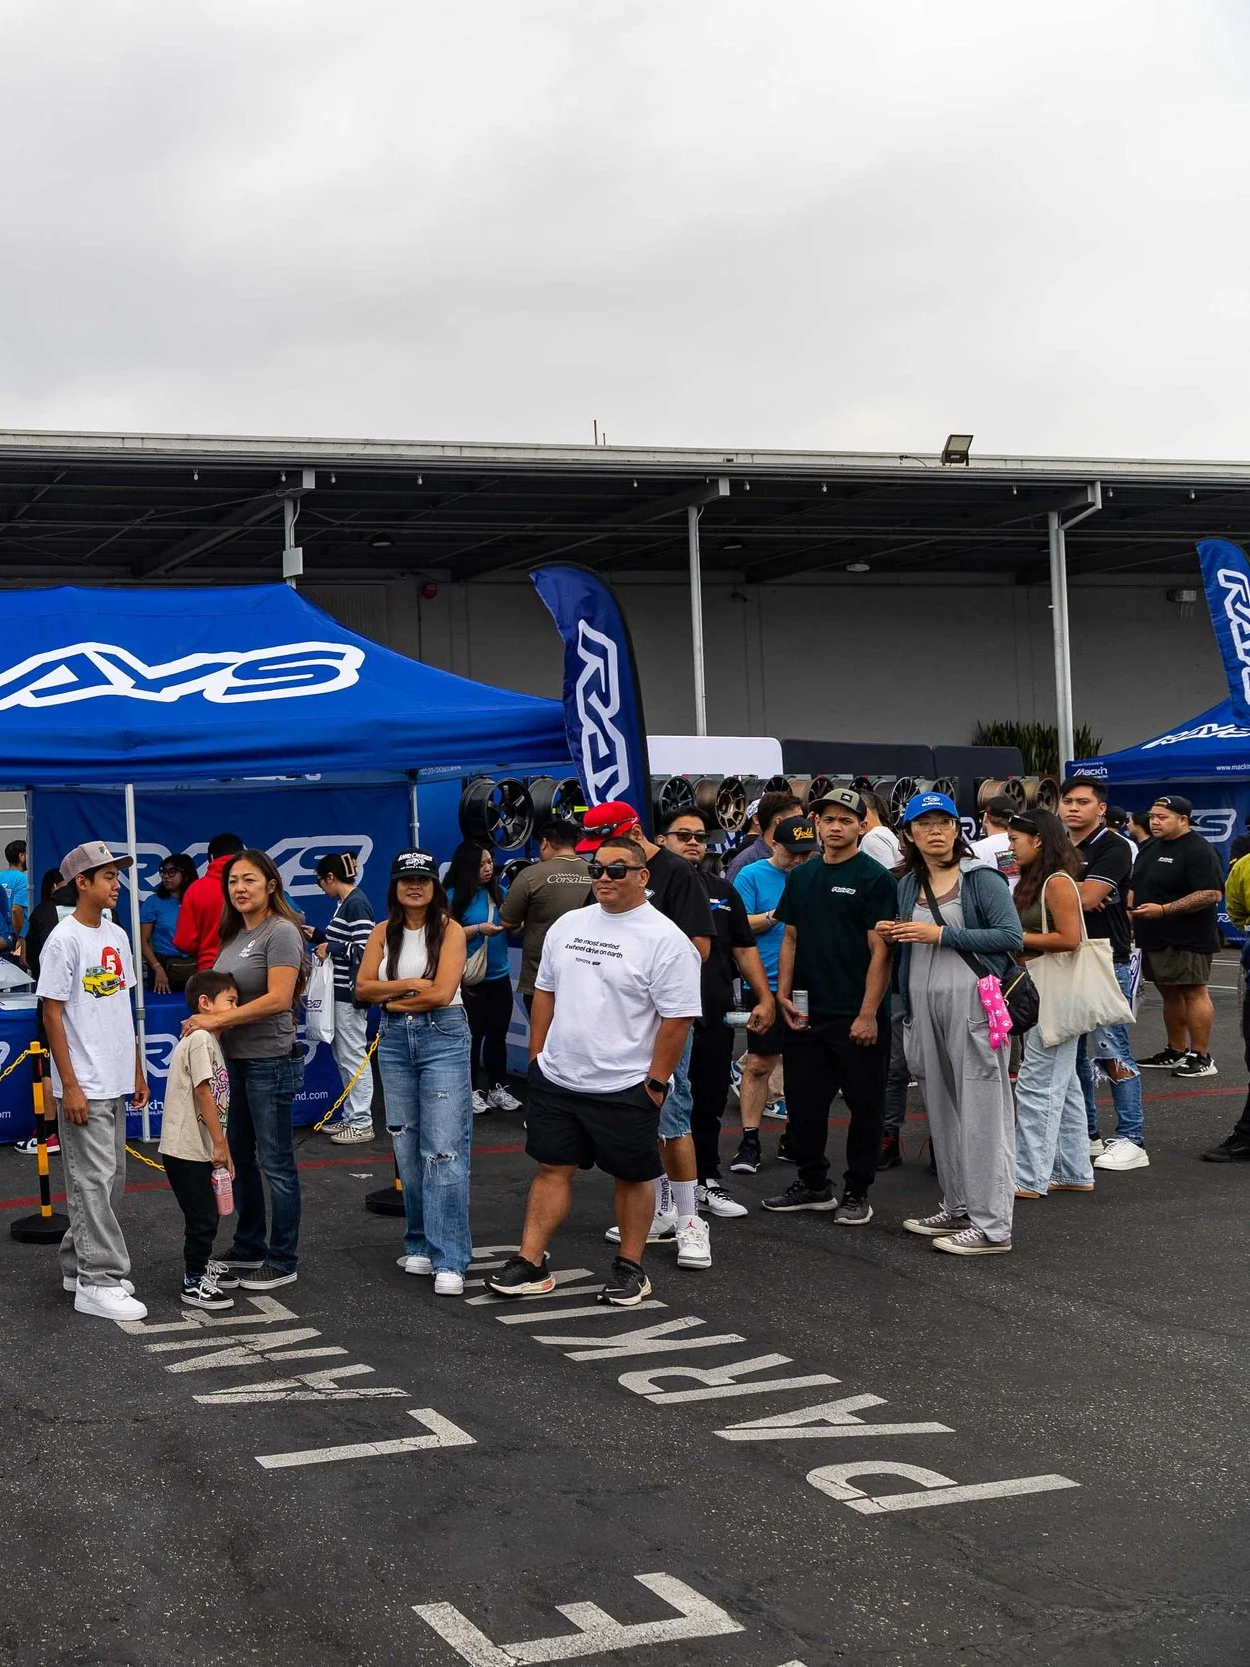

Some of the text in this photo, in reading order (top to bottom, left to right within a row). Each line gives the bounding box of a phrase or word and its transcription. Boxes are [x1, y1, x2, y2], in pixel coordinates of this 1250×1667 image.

[599, 942, 620, 950] wanted
[586, 946, 600, 954] drive
[607, 951, 623, 959] earth
